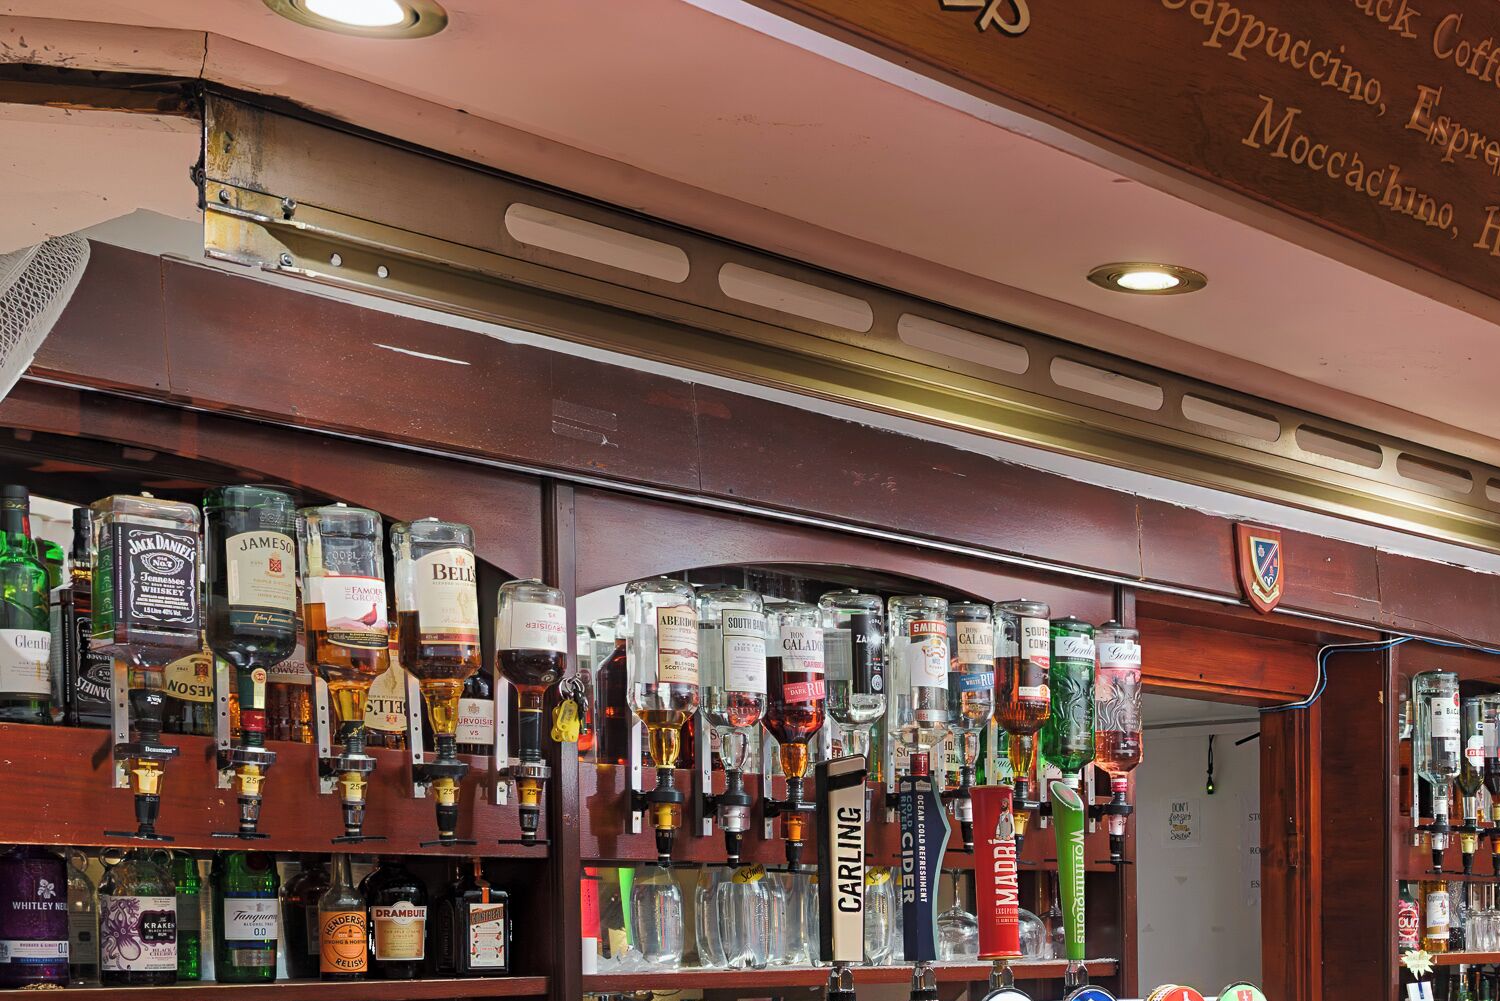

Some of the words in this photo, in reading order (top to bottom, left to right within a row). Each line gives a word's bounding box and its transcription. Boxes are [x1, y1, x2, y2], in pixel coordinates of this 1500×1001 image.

[1159, 0, 1387, 117] appuccino,
[1242, 94, 1459, 240] Moccachino,
[128, 537, 156, 555] JACK
[155, 534, 197, 562] DANIEL'S
[240, 537, 294, 556] JAMESO
[140, 572, 185, 586] Tennessee
[432, 563, 476, 583] BELL'S
[141, 586, 185, 597] WHISKEY
[352, 586, 383, 596] FAMOUS
[728, 617, 752, 630] SOUTH
[790, 631, 804, 639] RON
[790, 689, 806, 697] DARK
[144, 768, 156, 778] 25
[349, 783, 361, 791] 25
[443, 788, 453, 796] 25
[527, 788, 536, 797] 25
[905, 794, 913, 827] COLD
[917, 794, 925, 822] OCEAN
[918, 823, 926, 844] COLD
[837, 807, 863, 913] CARLING
[902, 832, 915, 904] CIDER
[918, 845, 928, 903] REFRESHMENT
[12, 901, 54, 911] WHITLEY
[375, 909, 425, 918] DRAMBUIE
[253, 927, 267, 936] 0.0
[58, 943, 67, 954] 0.0
[335, 958, 364, 968] RELISH
